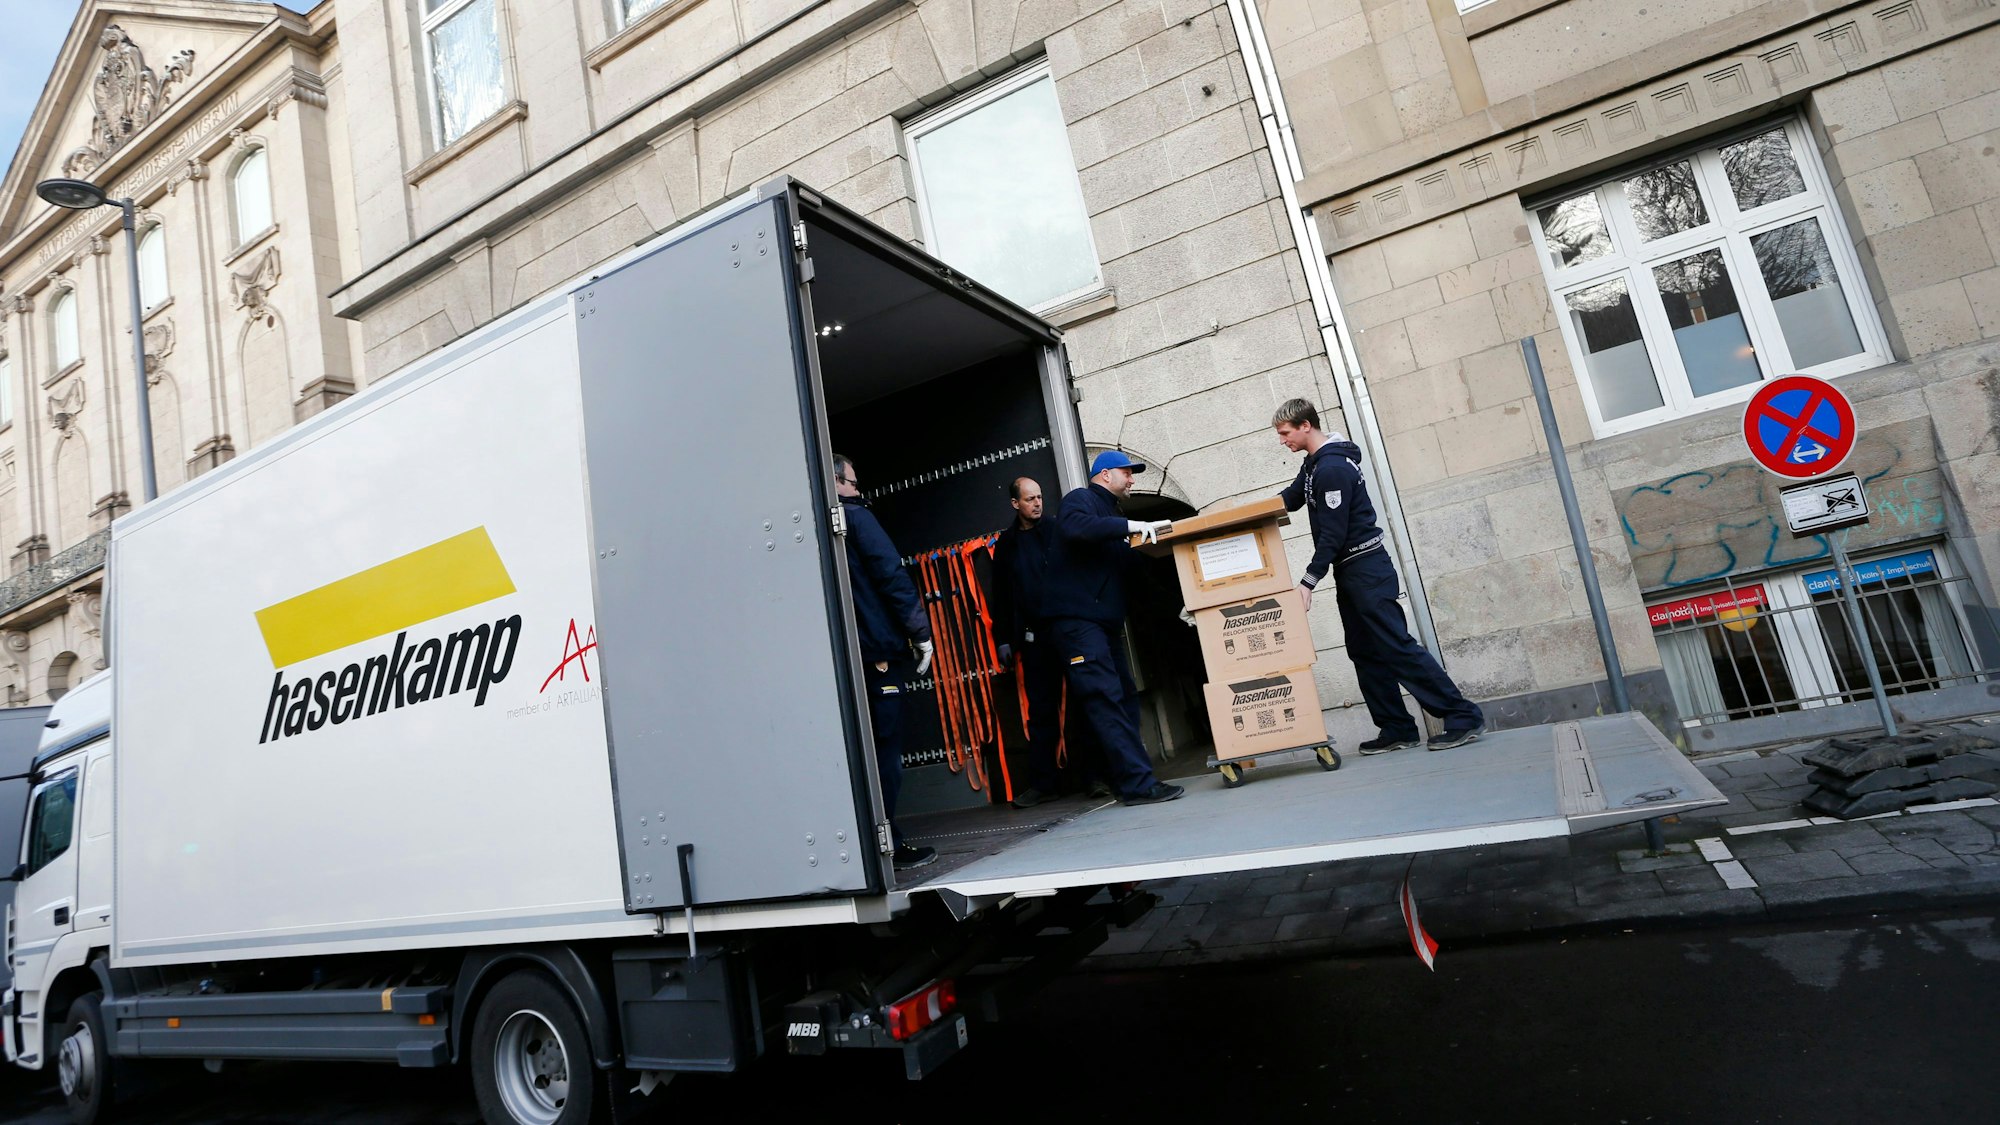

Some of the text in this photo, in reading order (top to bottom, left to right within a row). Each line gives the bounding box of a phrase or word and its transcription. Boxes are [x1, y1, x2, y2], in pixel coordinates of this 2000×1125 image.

[1861, 570, 1886, 580] Kölnr
[1700, 596, 1763, 612] Impovisatiostheatr
[1223, 609, 1283, 630] hasenkamp
[1223, 620, 1286, 637] RELOCATION SERVICES
[259, 614, 522, 744] hasenkamp
[1232, 685, 1293, 706] hasenkamp
[506, 701, 540, 720] member
[542, 695, 552, 711] of
[1231, 696, 1295, 713] RELOCATION SERVICES
[787, 1022, 821, 1037] MBB
